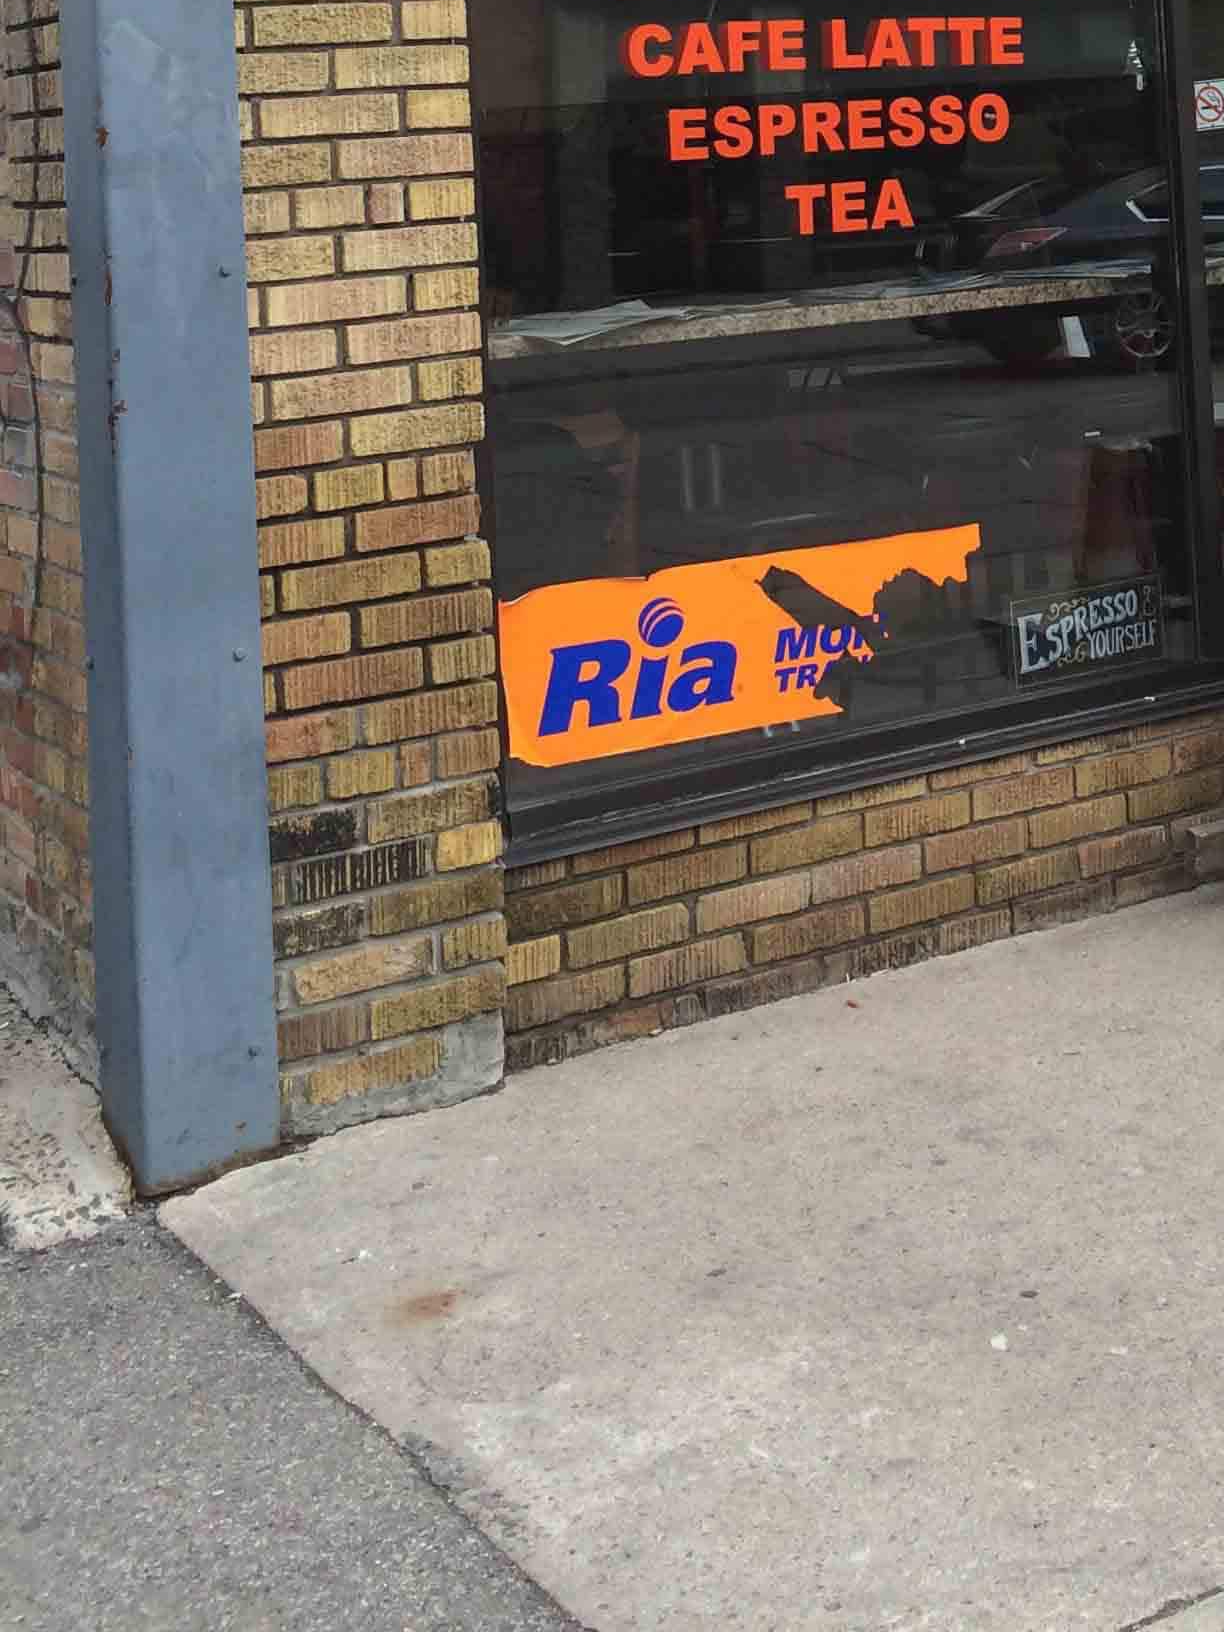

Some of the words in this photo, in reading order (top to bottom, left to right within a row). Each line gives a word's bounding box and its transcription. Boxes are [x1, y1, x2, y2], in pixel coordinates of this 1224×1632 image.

[627, 18, 807, 78] CAFE
[829, 16, 1026, 70] LATTE
[667, 93, 1011, 162] ESPRESSO
[785, 178, 916, 236] TEA
[1017, 589, 1139, 675] ESPRESSO
[1086, 620, 1157, 661] YOURSELF
[537, 596, 739, 738] Ria
[774, 659, 833, 694] TR
